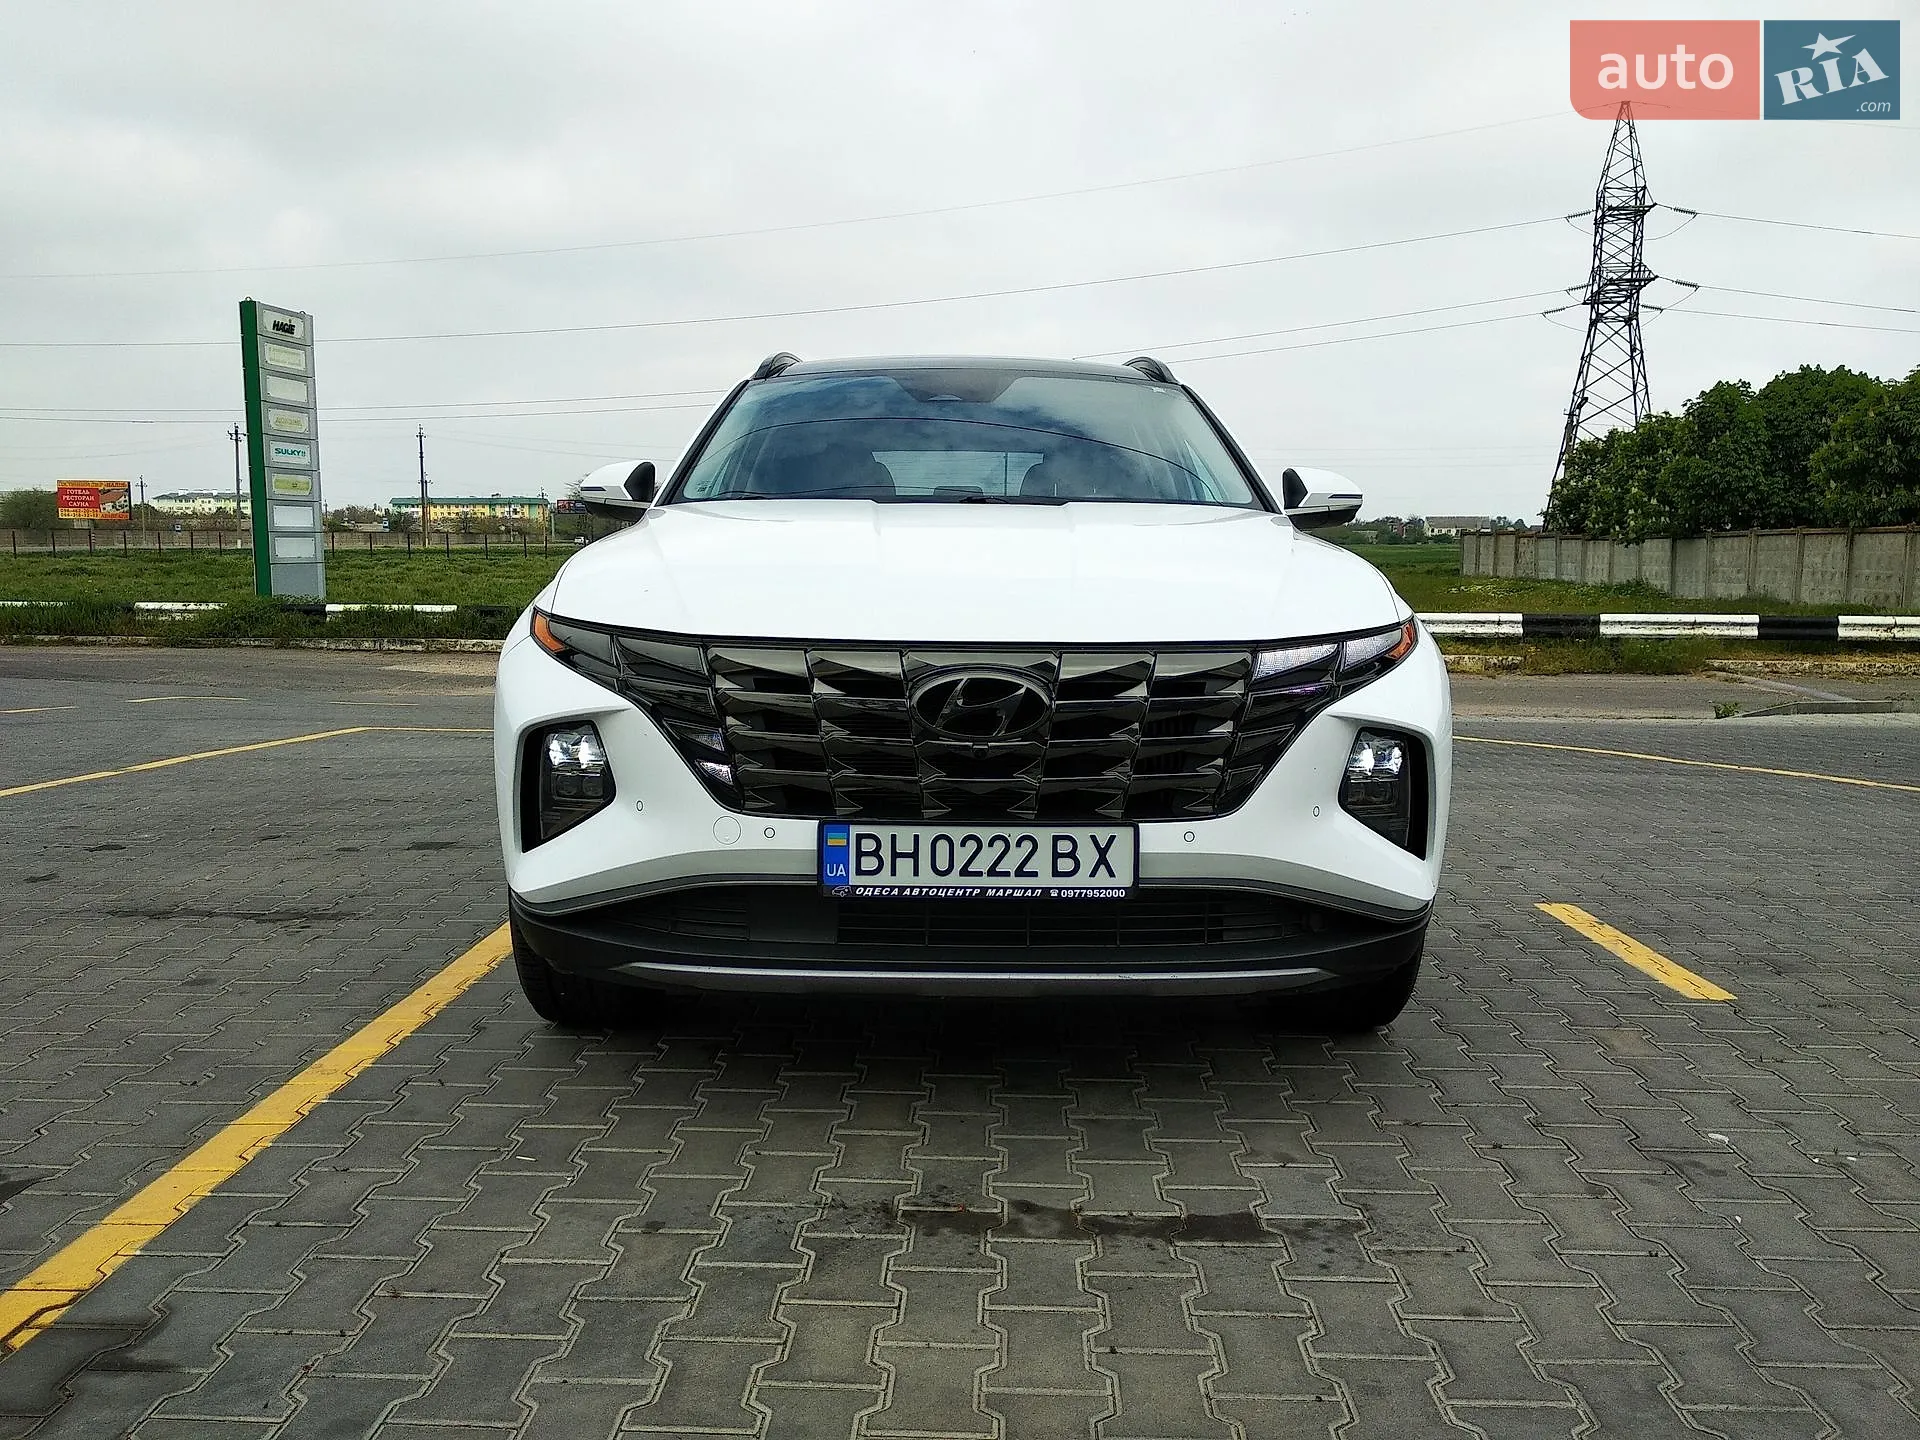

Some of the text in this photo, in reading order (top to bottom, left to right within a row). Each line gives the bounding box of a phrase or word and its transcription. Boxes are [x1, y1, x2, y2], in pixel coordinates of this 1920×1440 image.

[272, 320, 296, 335] HAGIE
[826, 863, 846, 877] UA
[855, 887, 1126, 898] ОДЕСА АВТОЦЕНТР МАРШАЛ 0977952000
